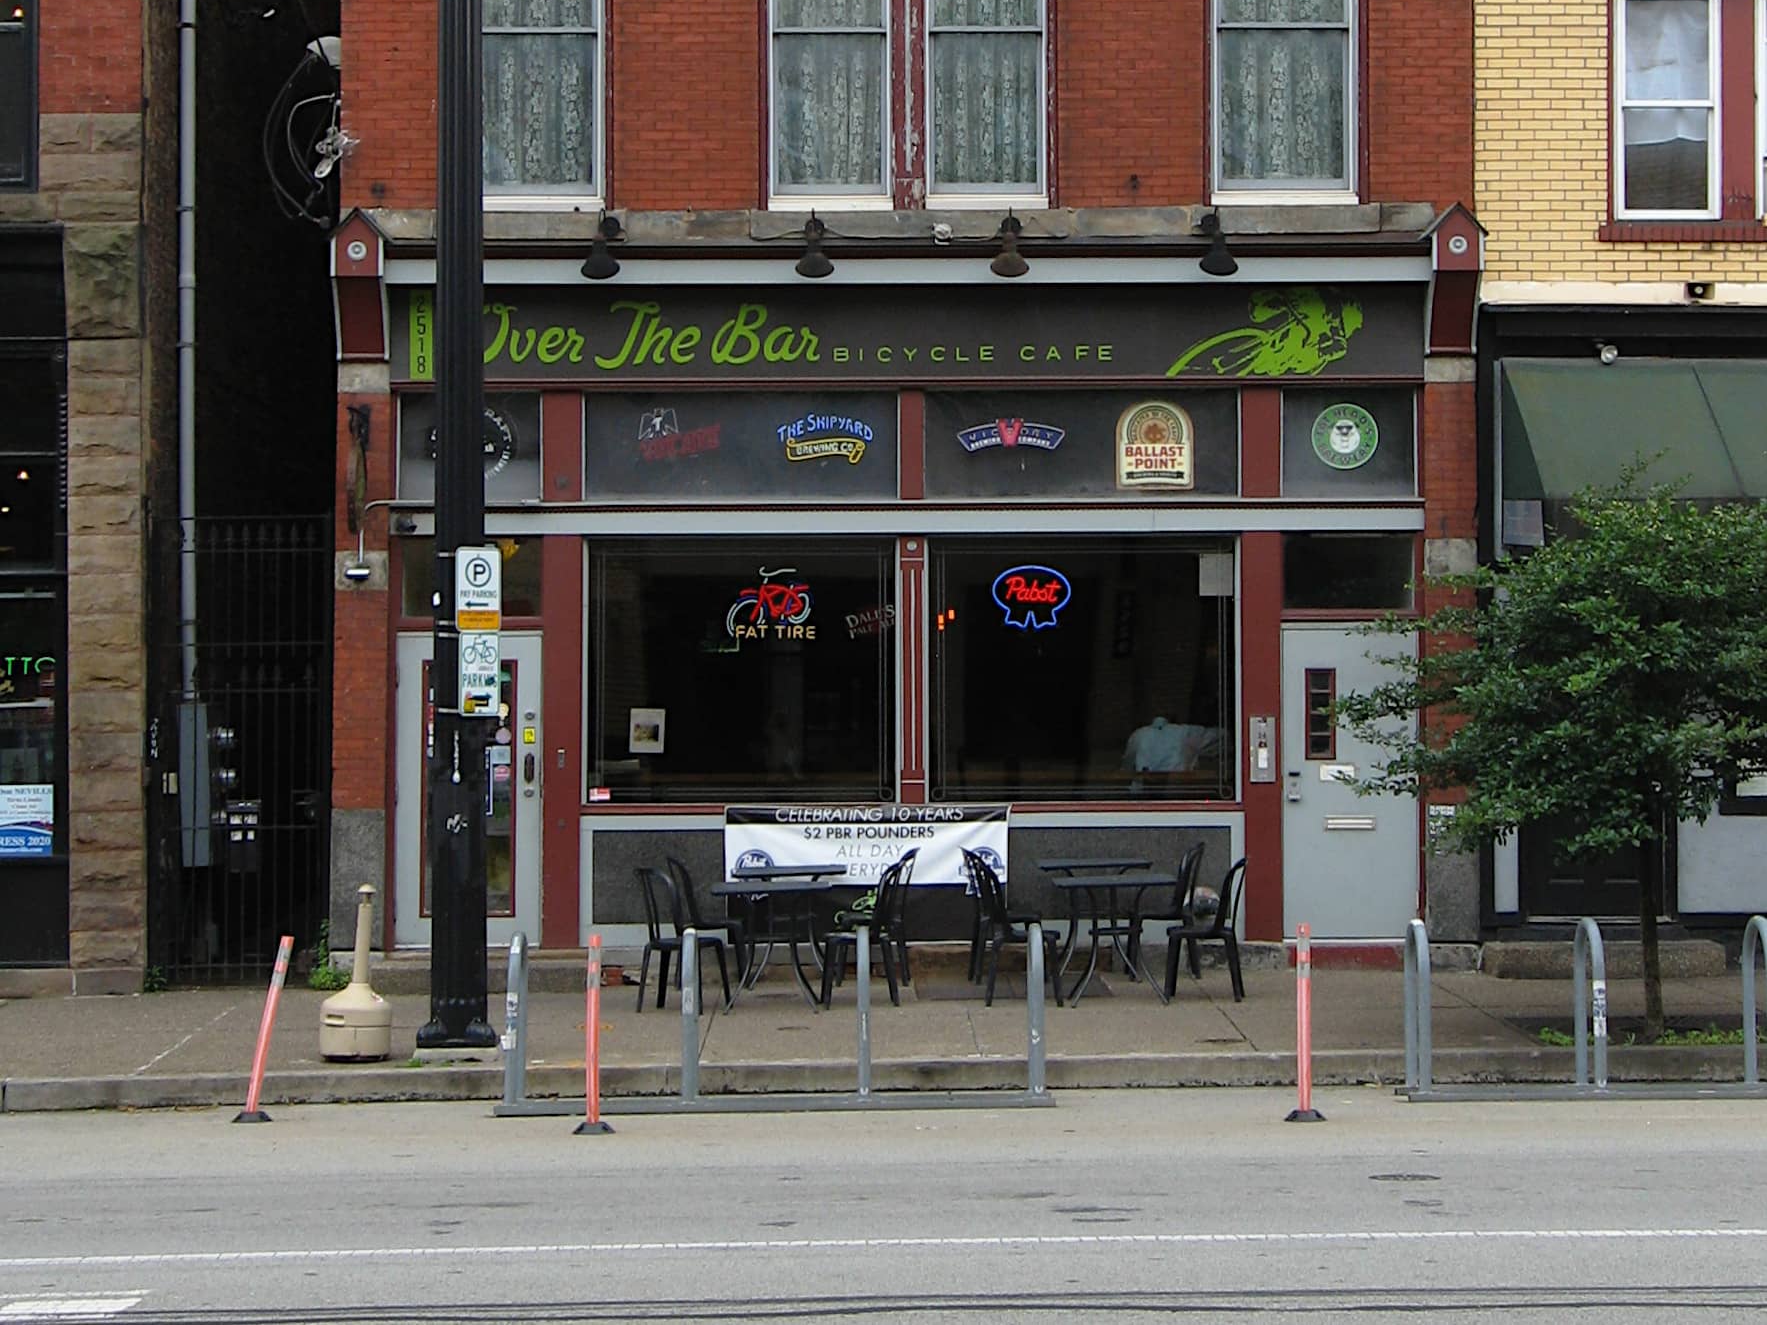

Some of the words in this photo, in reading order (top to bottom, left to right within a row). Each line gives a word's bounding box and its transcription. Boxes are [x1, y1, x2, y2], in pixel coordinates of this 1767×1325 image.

[416, 295, 426, 374] 2518
[594, 300, 702, 370] The
[711, 303, 822, 365] Bar
[833, 346, 995, 363] BICYCLE
[1020, 345, 1114, 362] CAFE
[777, 420, 805, 443] THE
[806, 413, 873, 442] SHIPYARD
[1124, 446, 1185, 457] BALLAST
[1134, 458, 1177, 469] POINT
[473, 563, 487, 582] P
[1005, 576, 1062, 602] Pabst
[735, 624, 769, 640] FAT
[774, 624, 817, 640] TIRE
[462, 673, 497, 688] PARKI
[775, 807, 883, 823] CELEBRATING
[891, 807, 911, 821] 10
[916, 807, 965, 821] YEARS
[804, 826, 821, 840] $2
[826, 826, 852, 840] PBR
[857, 826, 935, 839] POUNDERS
[836, 844, 863, 858] ALL
[870, 844, 905, 858] DAY
